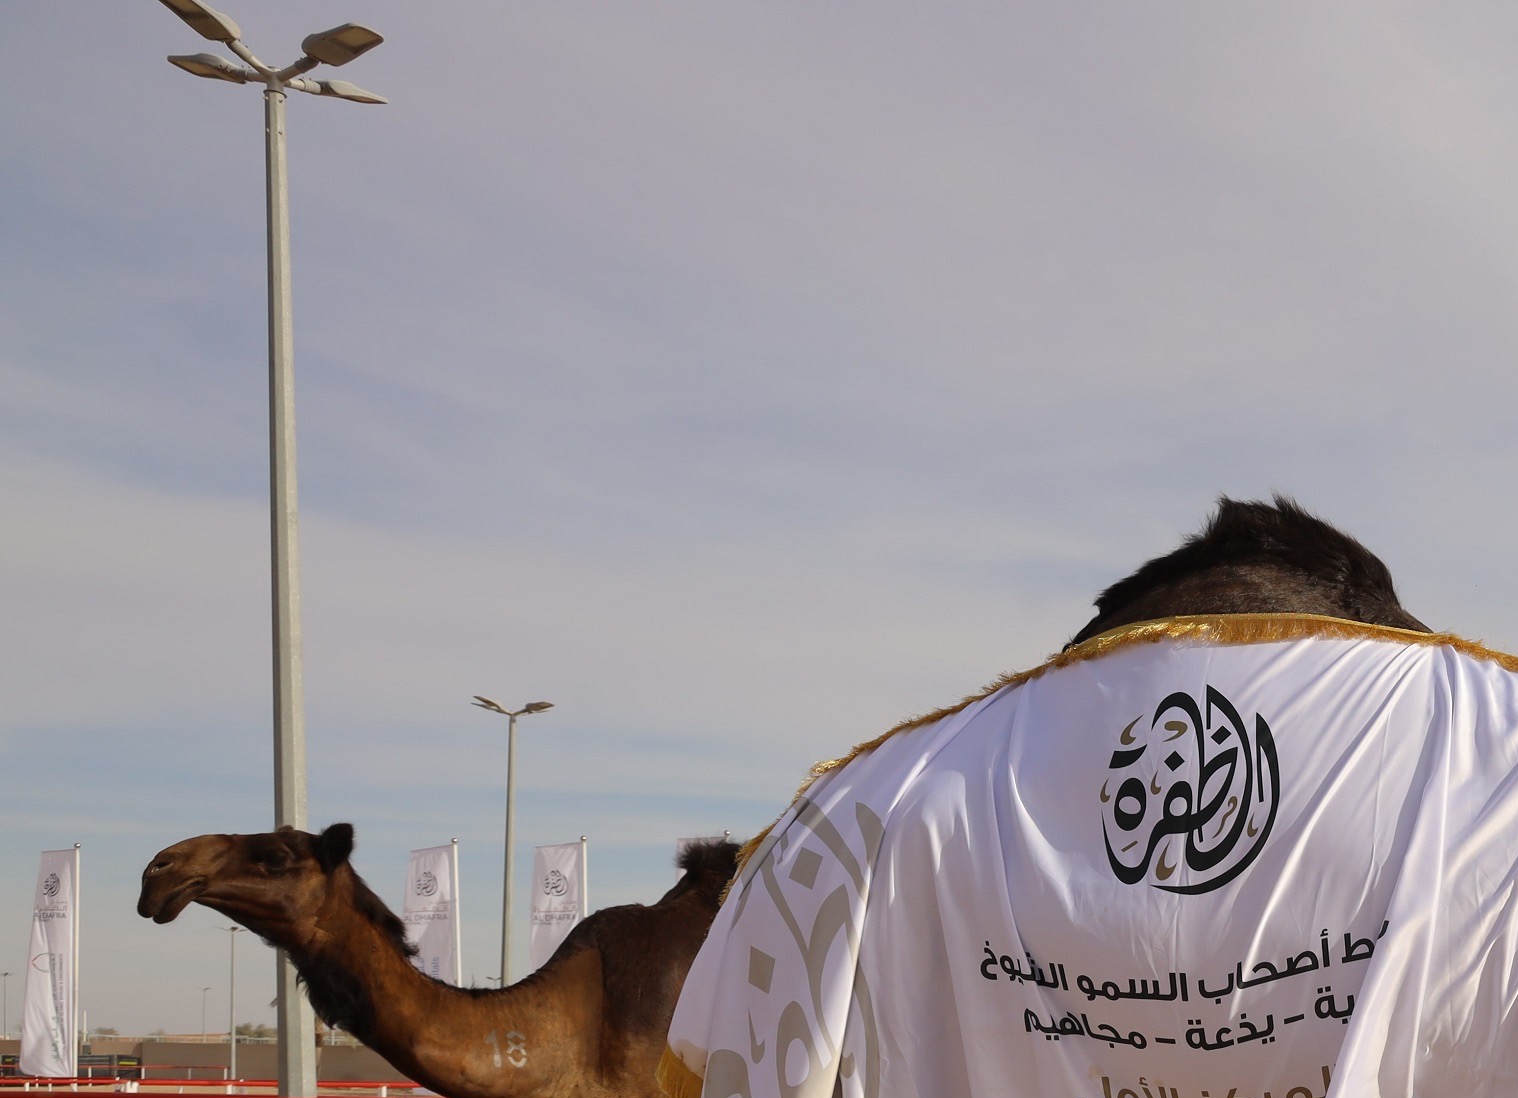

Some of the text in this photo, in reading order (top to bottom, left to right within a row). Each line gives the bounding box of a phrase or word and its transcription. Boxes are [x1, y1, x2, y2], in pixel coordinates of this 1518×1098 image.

[1077, 972, 1188, 1002] السمو
[1199, 929, 1331, 1005] أصحاب
[1024, 1007, 1147, 1049] مجاهيم
[485, 1030, 527, 1068] 18
